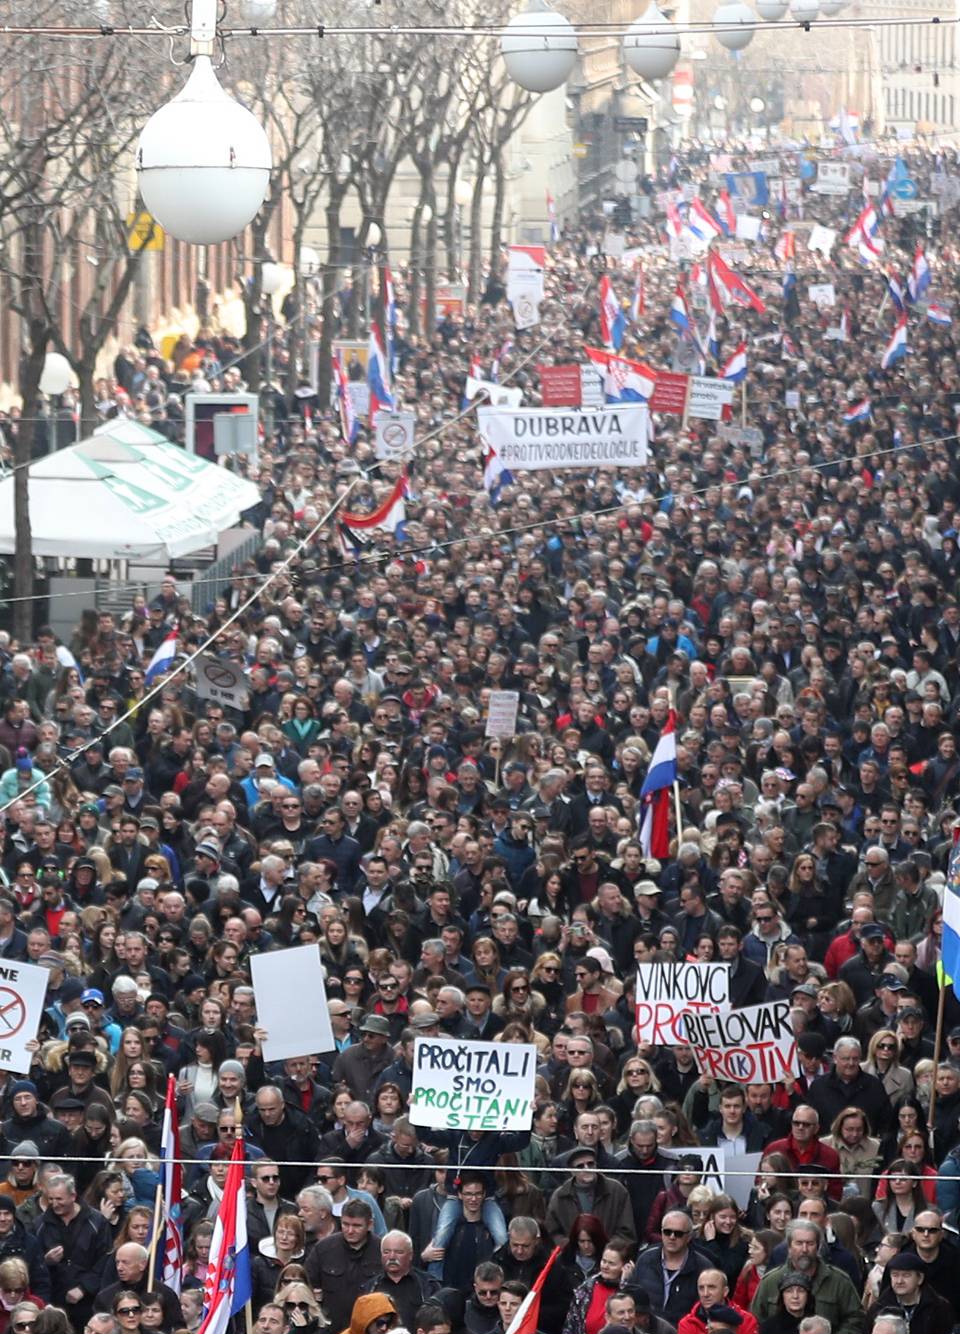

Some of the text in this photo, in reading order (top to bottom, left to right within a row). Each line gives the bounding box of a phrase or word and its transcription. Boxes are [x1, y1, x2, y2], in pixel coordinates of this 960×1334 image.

[513, 414, 622, 438] DUBRAVA
[637, 963, 732, 1004] VINKOVCI
[636, 1002, 720, 1046] PRO
[682, 1002, 794, 1050] BJELOVAR
[418, 1043, 529, 1077] PROČITALI
[695, 1040, 799, 1084] PROTIV
[414, 1086, 528, 1117] PROČITANI
[453, 1075, 503, 1097] SMO,
